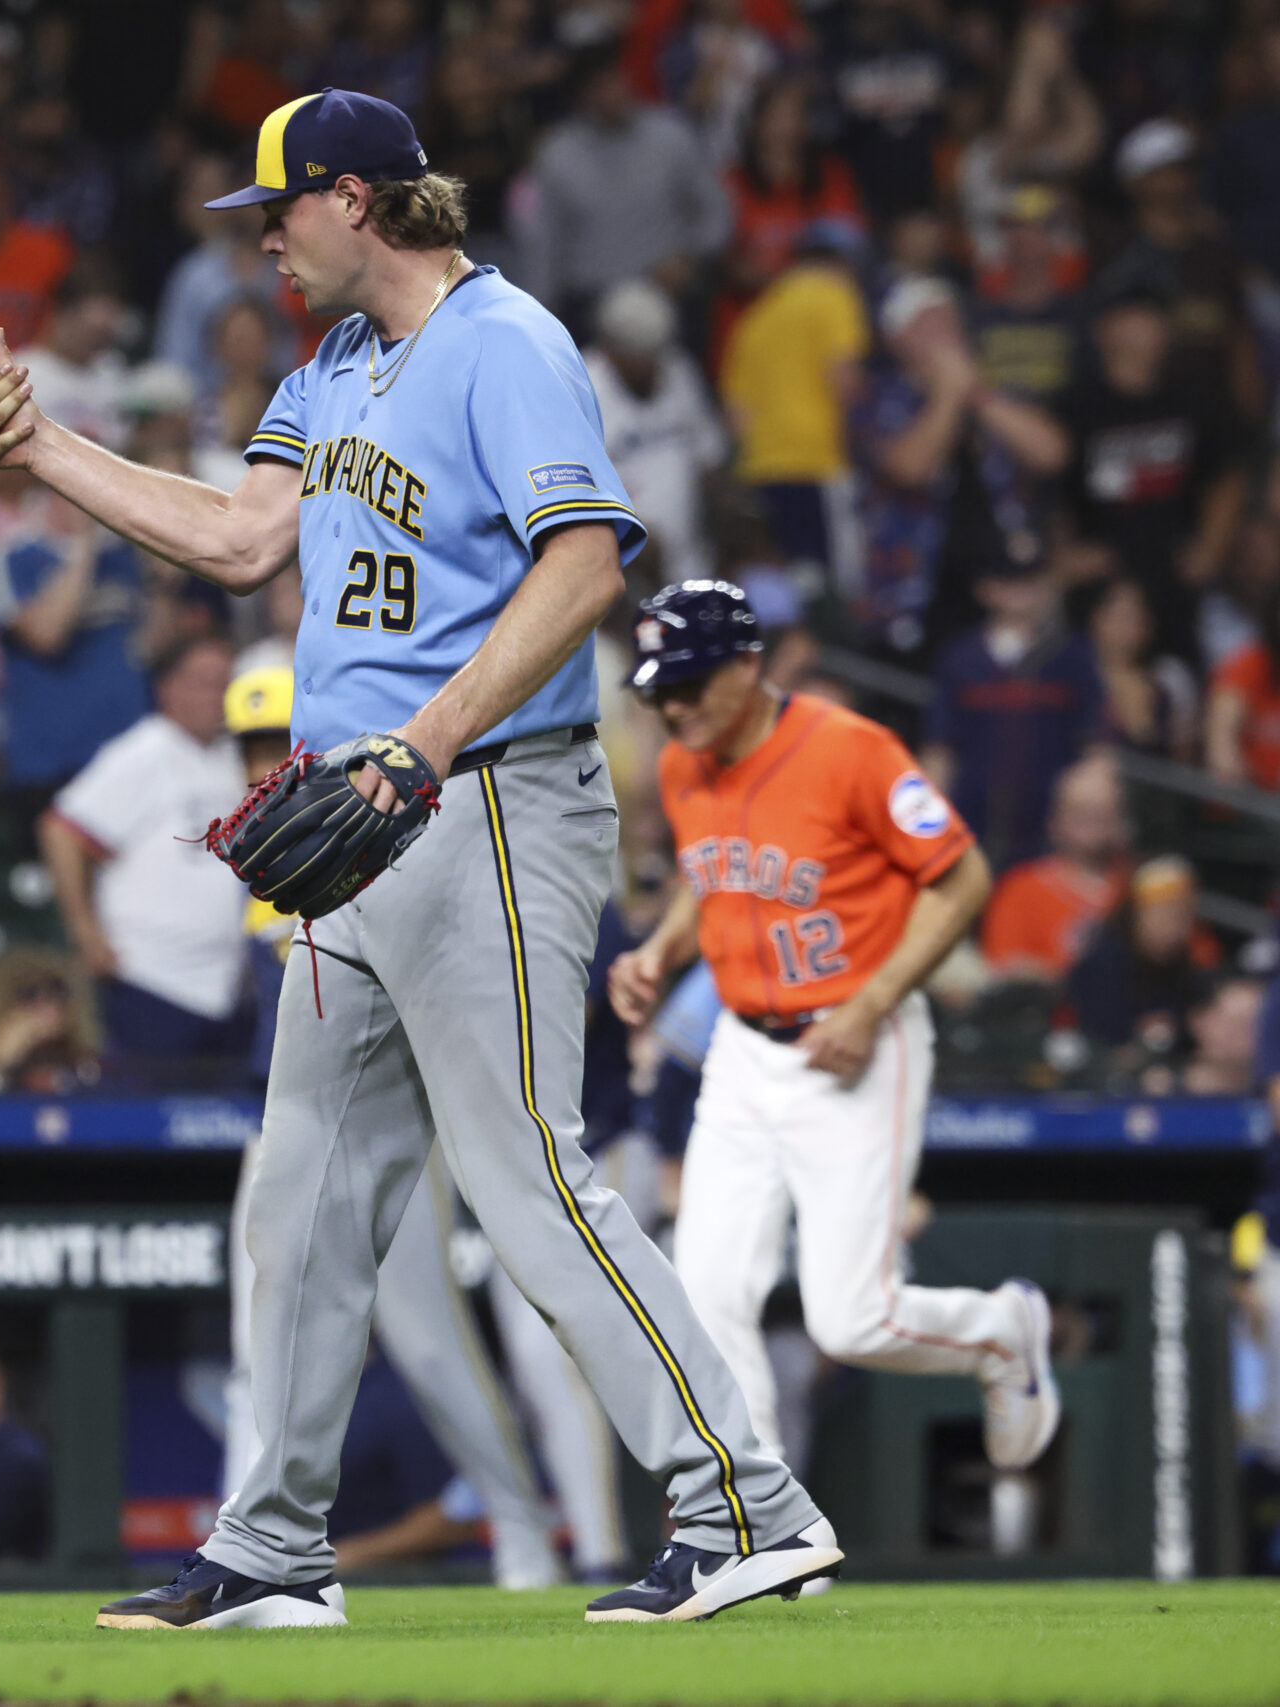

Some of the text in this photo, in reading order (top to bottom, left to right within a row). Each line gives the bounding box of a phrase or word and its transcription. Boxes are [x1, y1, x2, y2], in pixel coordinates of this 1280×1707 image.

[334, 548, 418, 635] 29
[679, 836, 826, 911] STROS
[768, 909, 851, 988] 12
[99, 1224, 222, 1289] LOSE
